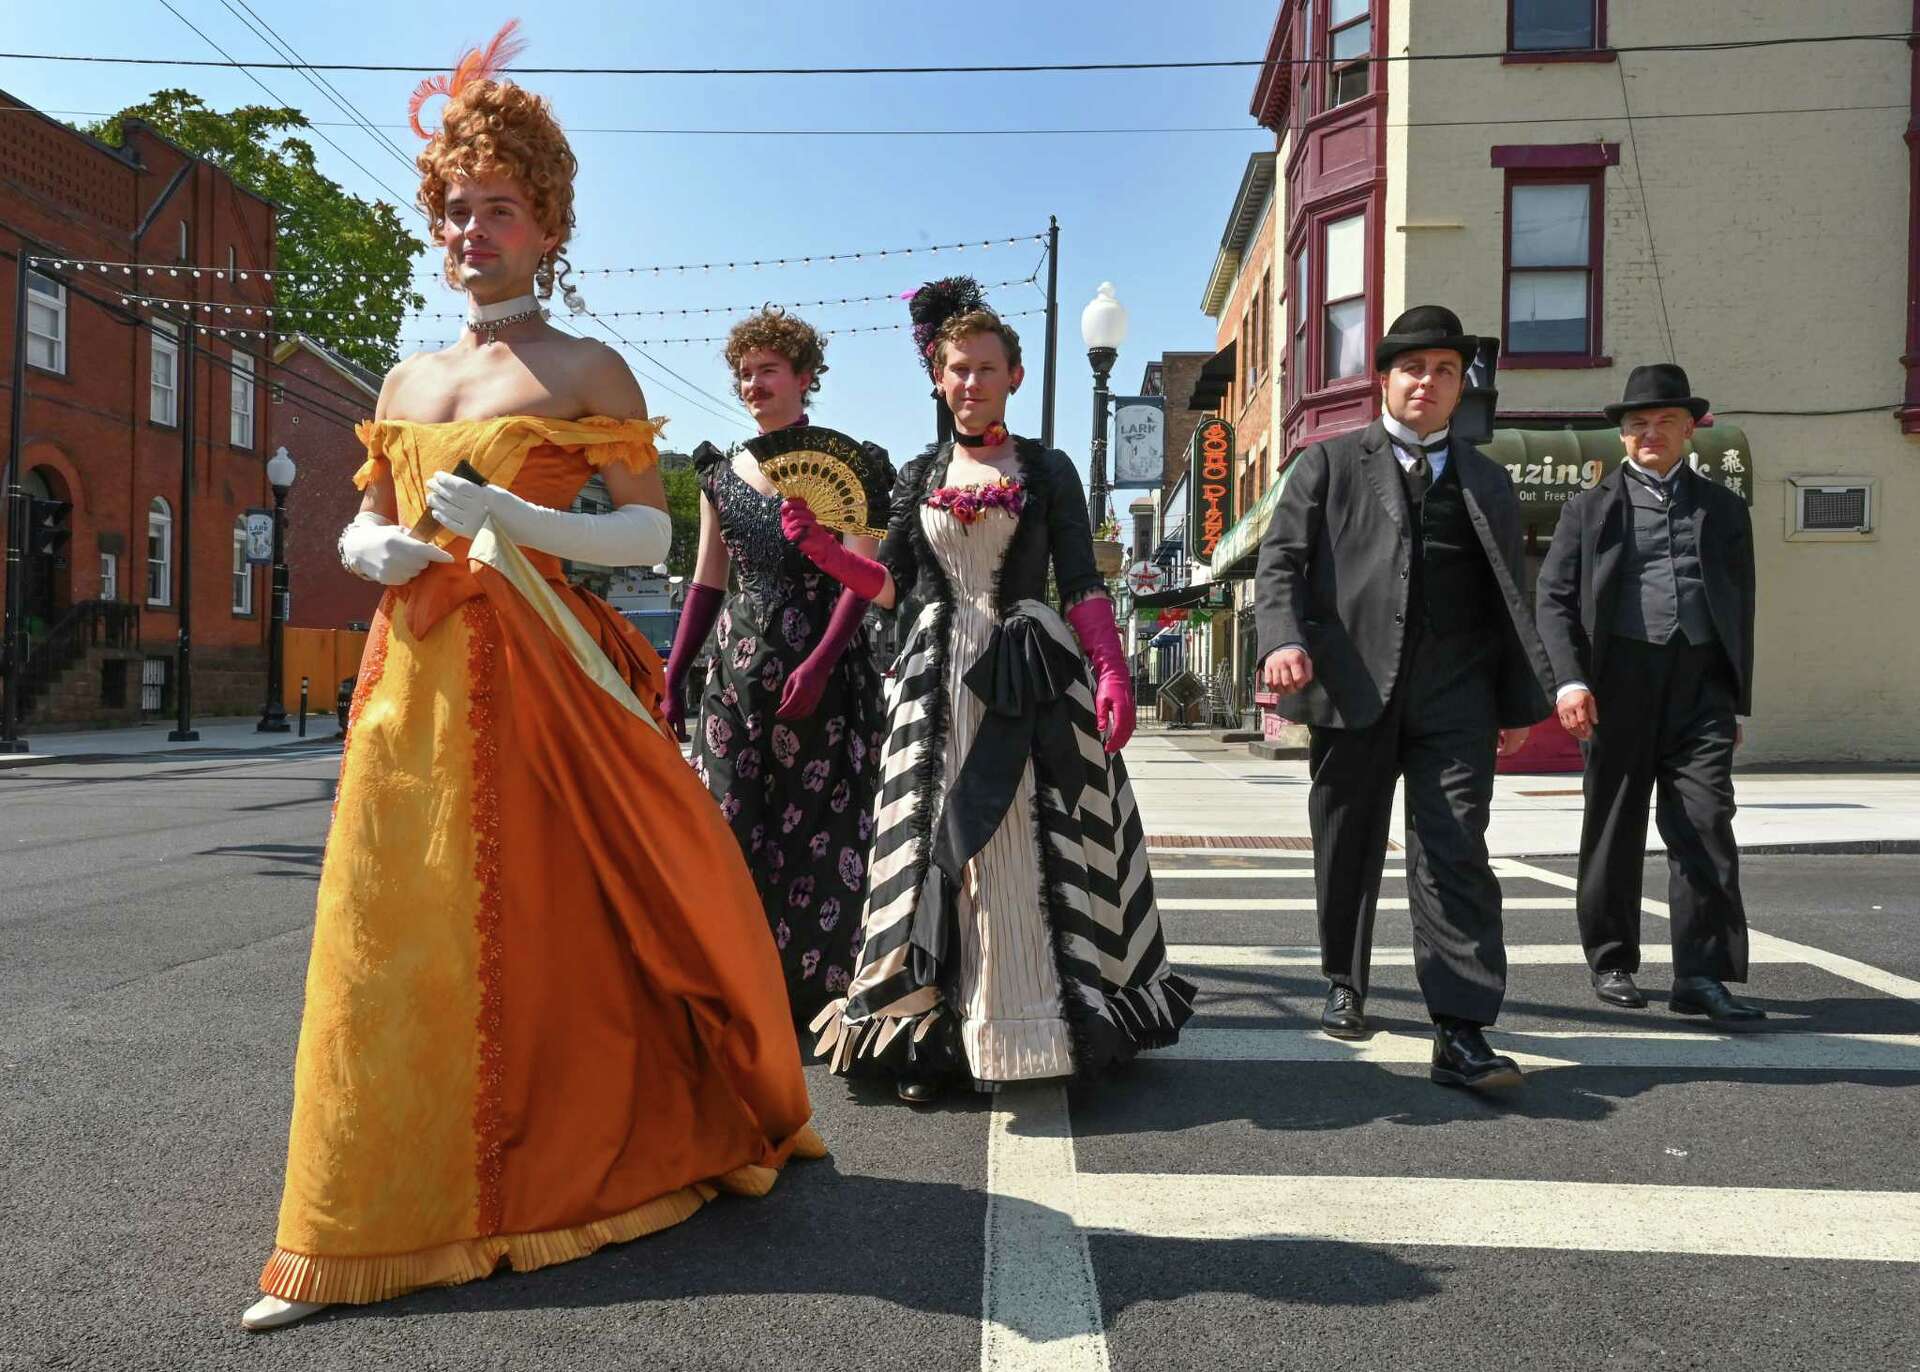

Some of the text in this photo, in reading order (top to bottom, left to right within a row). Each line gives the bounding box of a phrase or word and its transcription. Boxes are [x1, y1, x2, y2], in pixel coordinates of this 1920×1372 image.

[1120, 423, 1158, 434] LARK
[1202, 423, 1228, 480] SOHO
[1519, 490, 1537, 501] Out
[1544, 490, 1566, 501] Free
